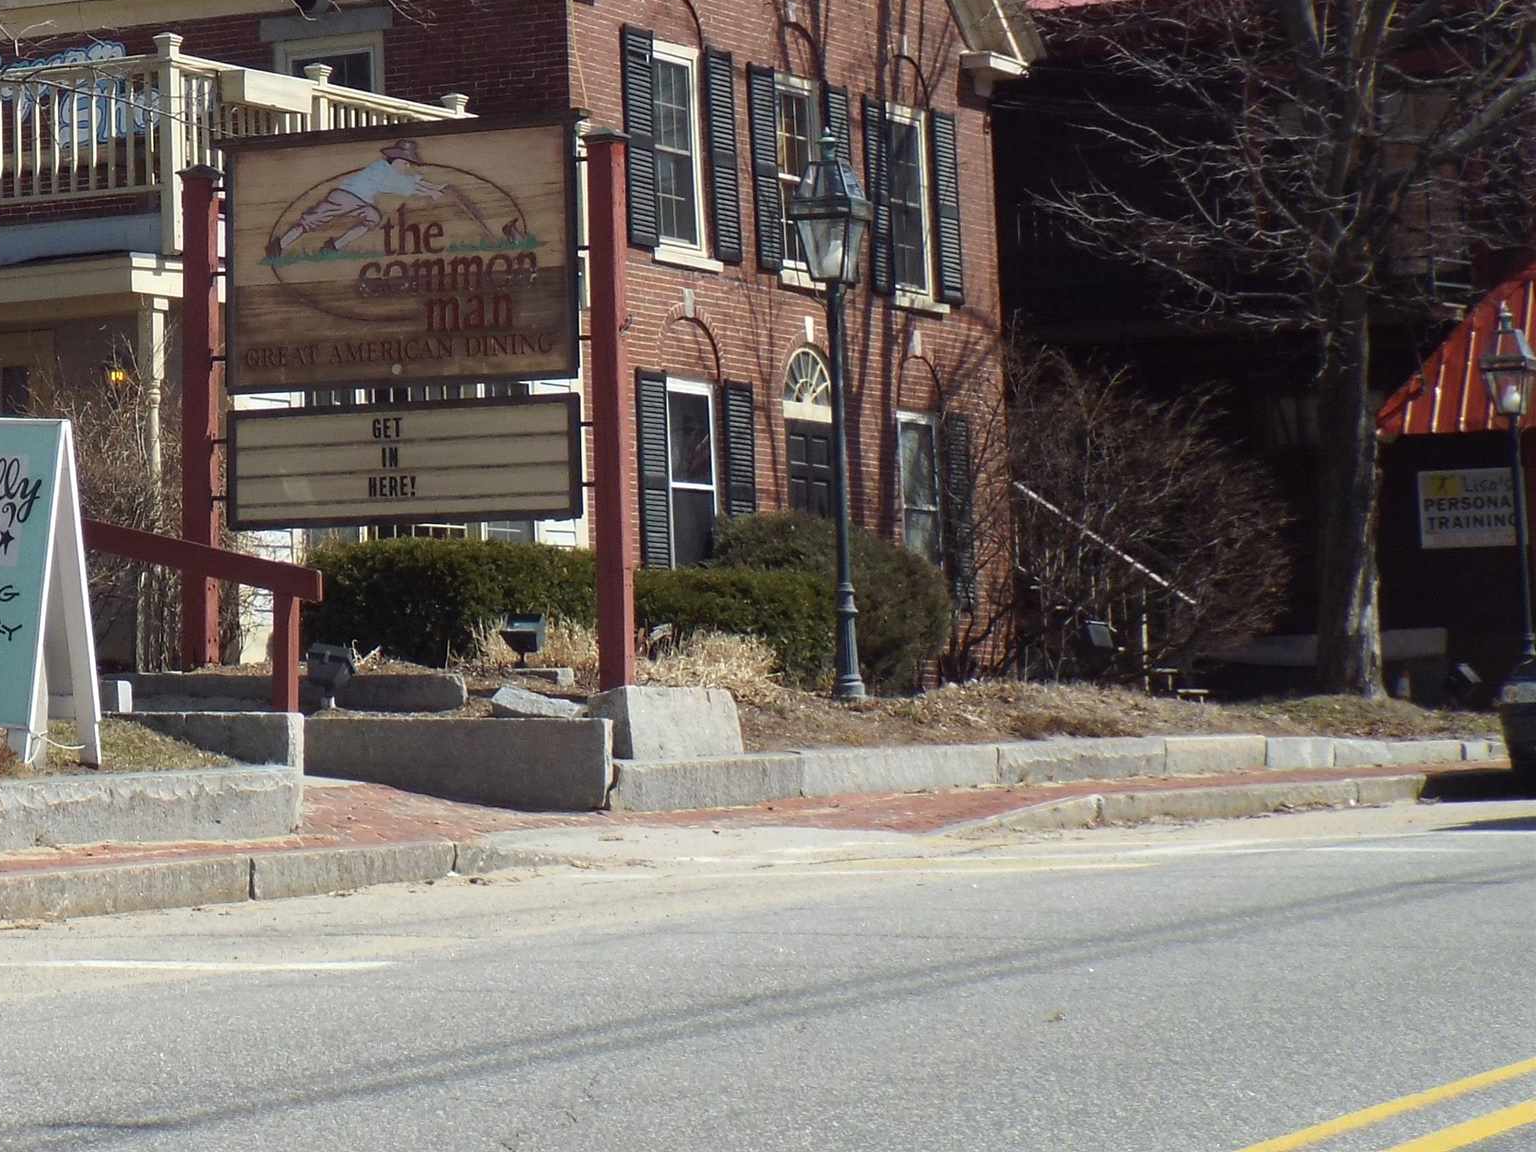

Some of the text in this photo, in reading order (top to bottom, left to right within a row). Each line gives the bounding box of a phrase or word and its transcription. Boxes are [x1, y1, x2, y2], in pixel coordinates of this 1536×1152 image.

[381, 203, 445, 256] the
[357, 250, 538, 297] common
[424, 291, 513, 332] man
[246, 332, 554, 369] GREAT AMERICAN DINING
[371, 417, 402, 439] GET
[381, 448, 398, 468] IN
[367, 476, 416, 497] HERE!
